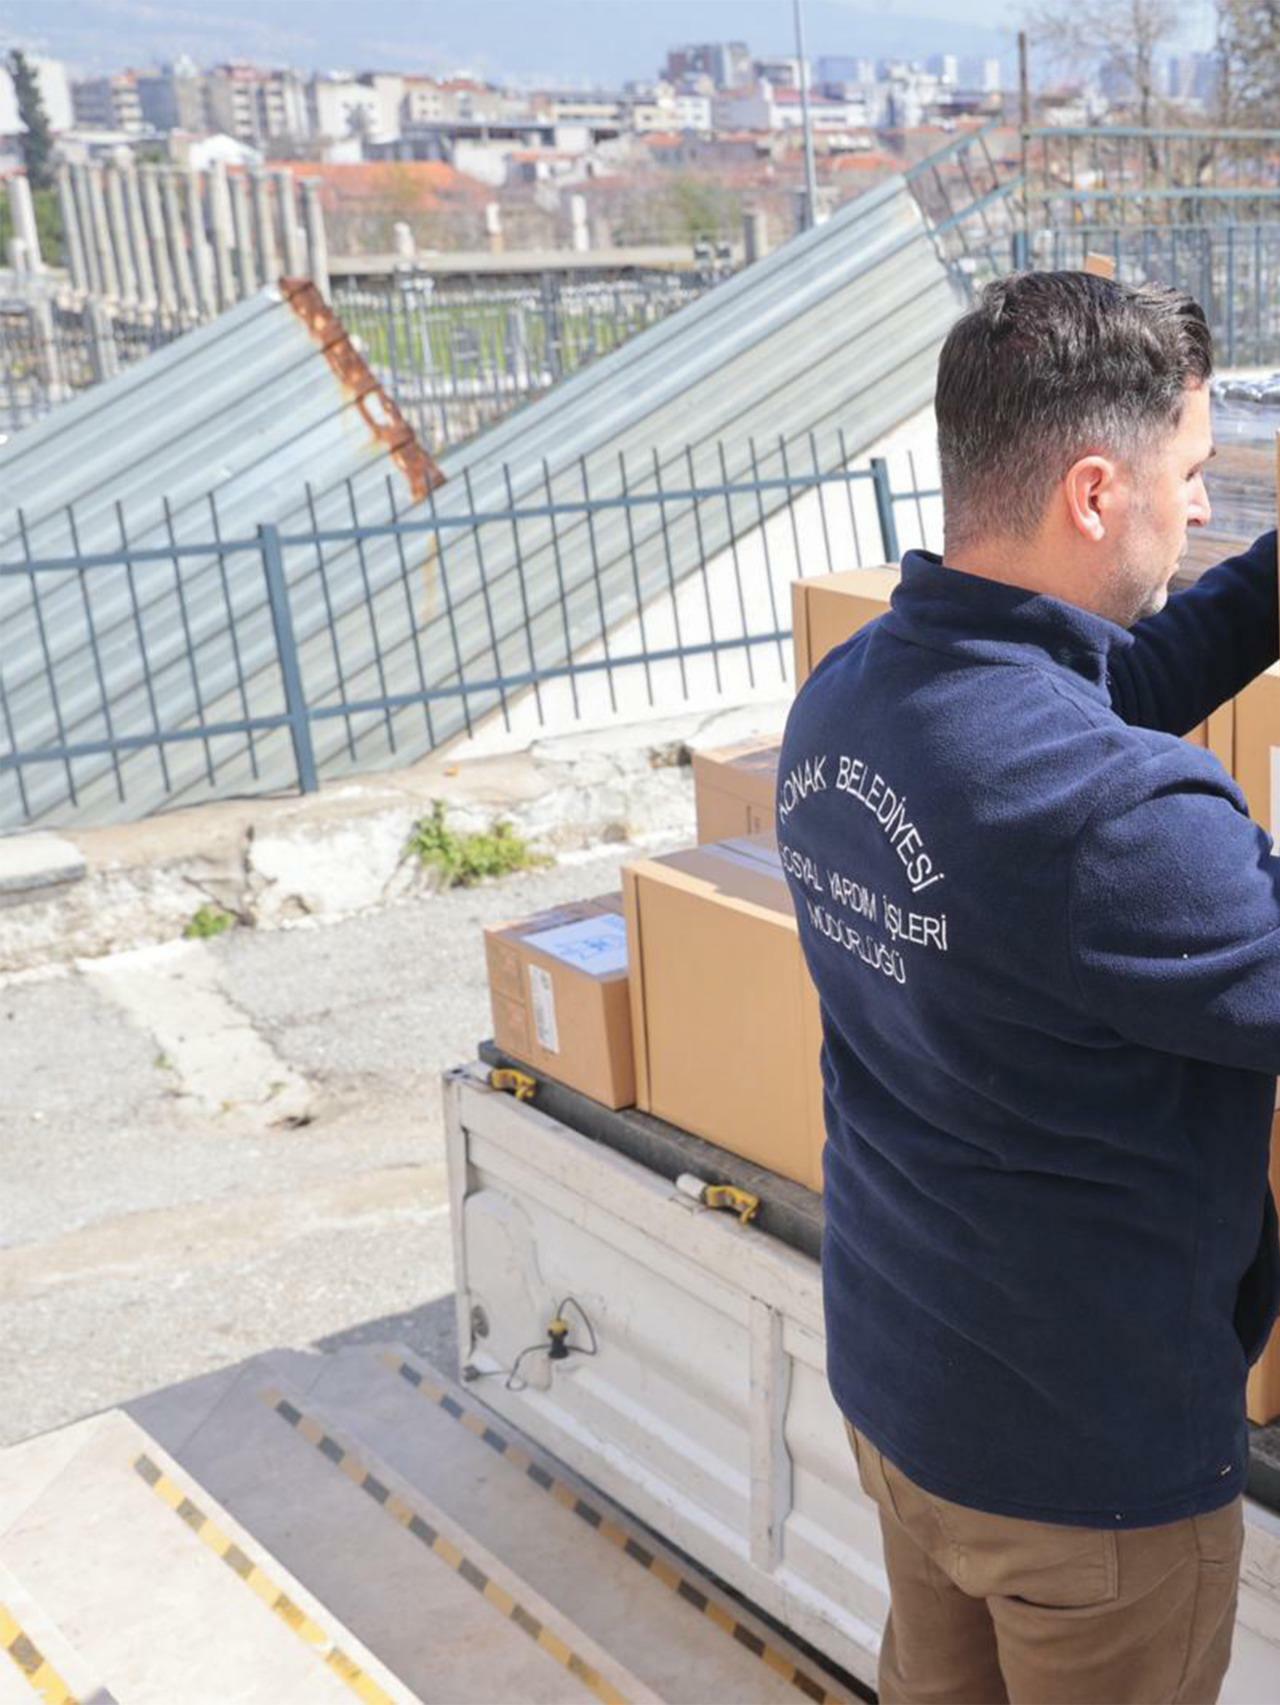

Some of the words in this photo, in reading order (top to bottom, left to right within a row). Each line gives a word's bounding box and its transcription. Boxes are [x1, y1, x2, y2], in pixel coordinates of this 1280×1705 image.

[835, 755, 945, 892] BELEDİYESİ
[806, 902, 907, 985] MÜDÜRLÜĞÜ
[827, 870, 877, 923] YARDIM
[882, 894, 948, 951] İŞLERİ
